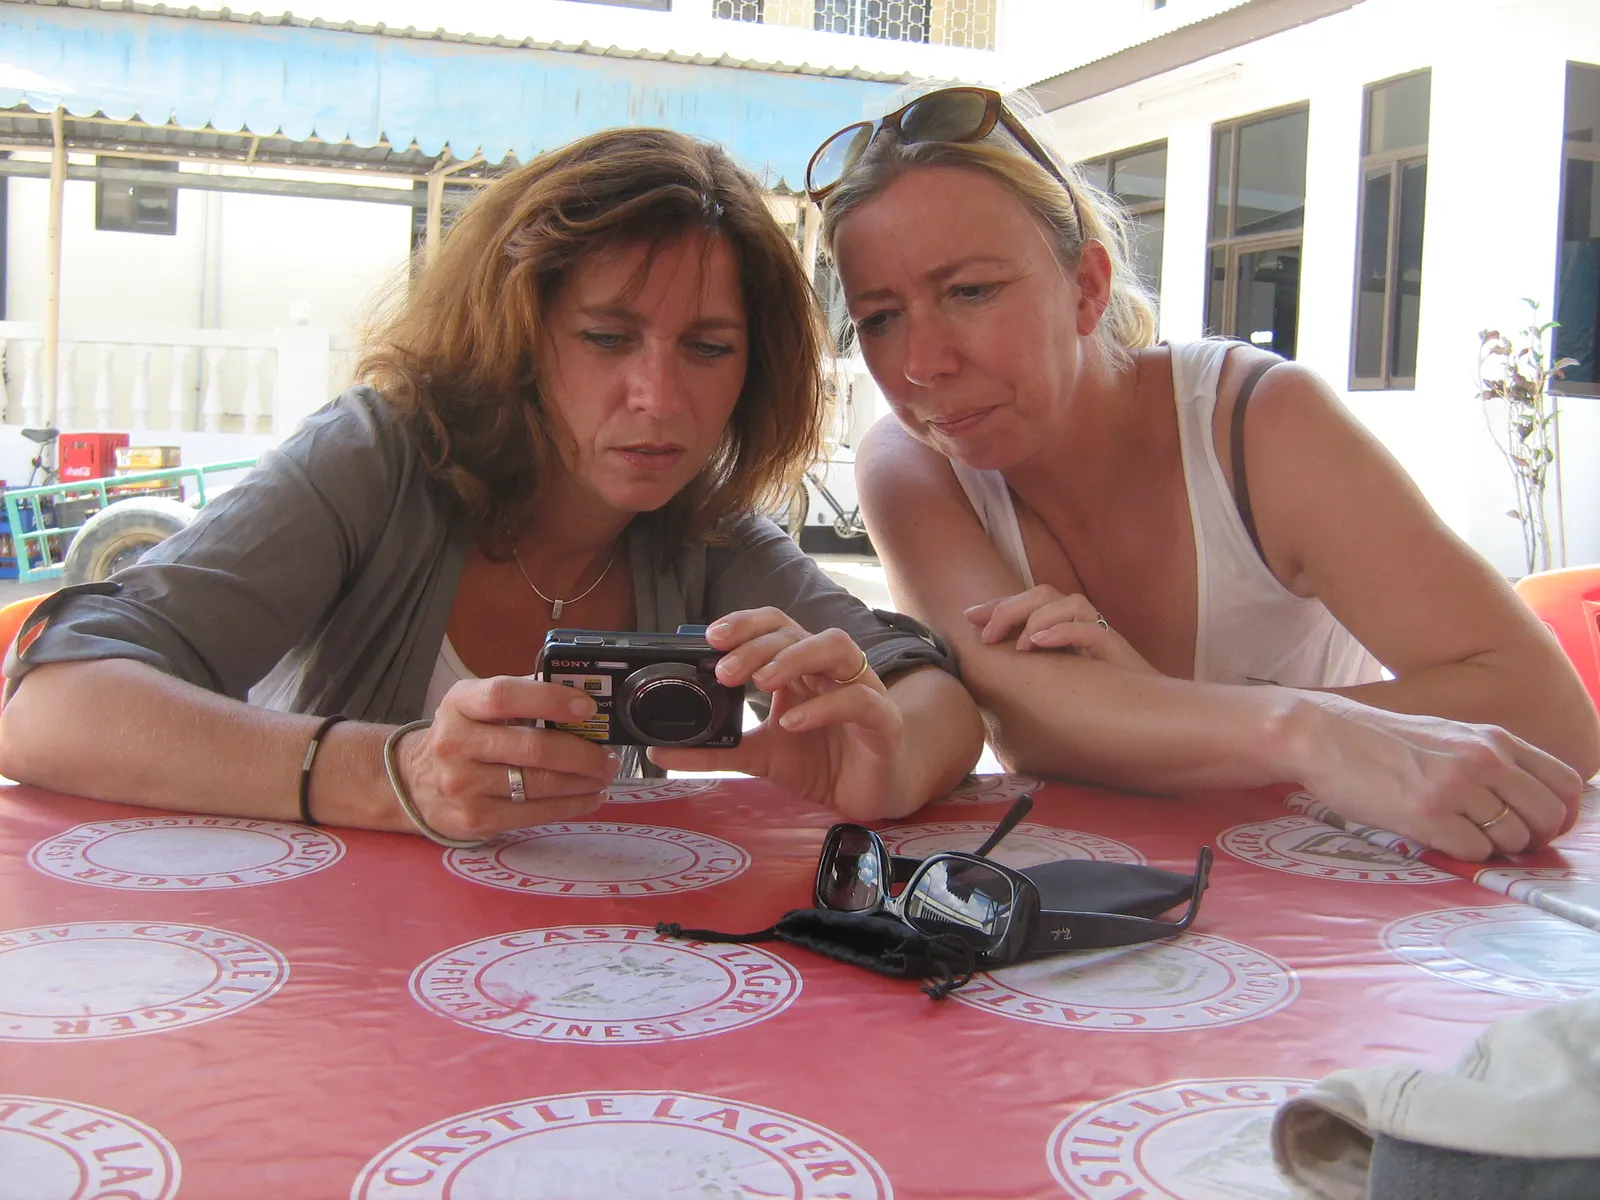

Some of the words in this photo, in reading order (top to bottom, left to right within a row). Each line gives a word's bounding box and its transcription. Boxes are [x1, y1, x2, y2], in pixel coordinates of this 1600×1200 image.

[255, 832, 331, 877] CASTLE
[588, 824, 721, 849] AFRICA'S
[1231, 832, 1304, 868] LAGER
[73, 868, 245, 886] LAGER
[458, 856, 576, 893] LAGER
[597, 857, 737, 894] CASTLE
[1314, 867, 1443, 881] STLE
[131, 925, 272, 979] CASTLE
[429, 958, 505, 1021] AFRICA'S
[511, 1018, 686, 1038] FINEST
[717, 950, 782, 1013] LAGER
[53, 986, 258, 1035] LAGER
[384, 1098, 622, 1187] CASTLE
[652, 1097, 858, 1183] LAGER
